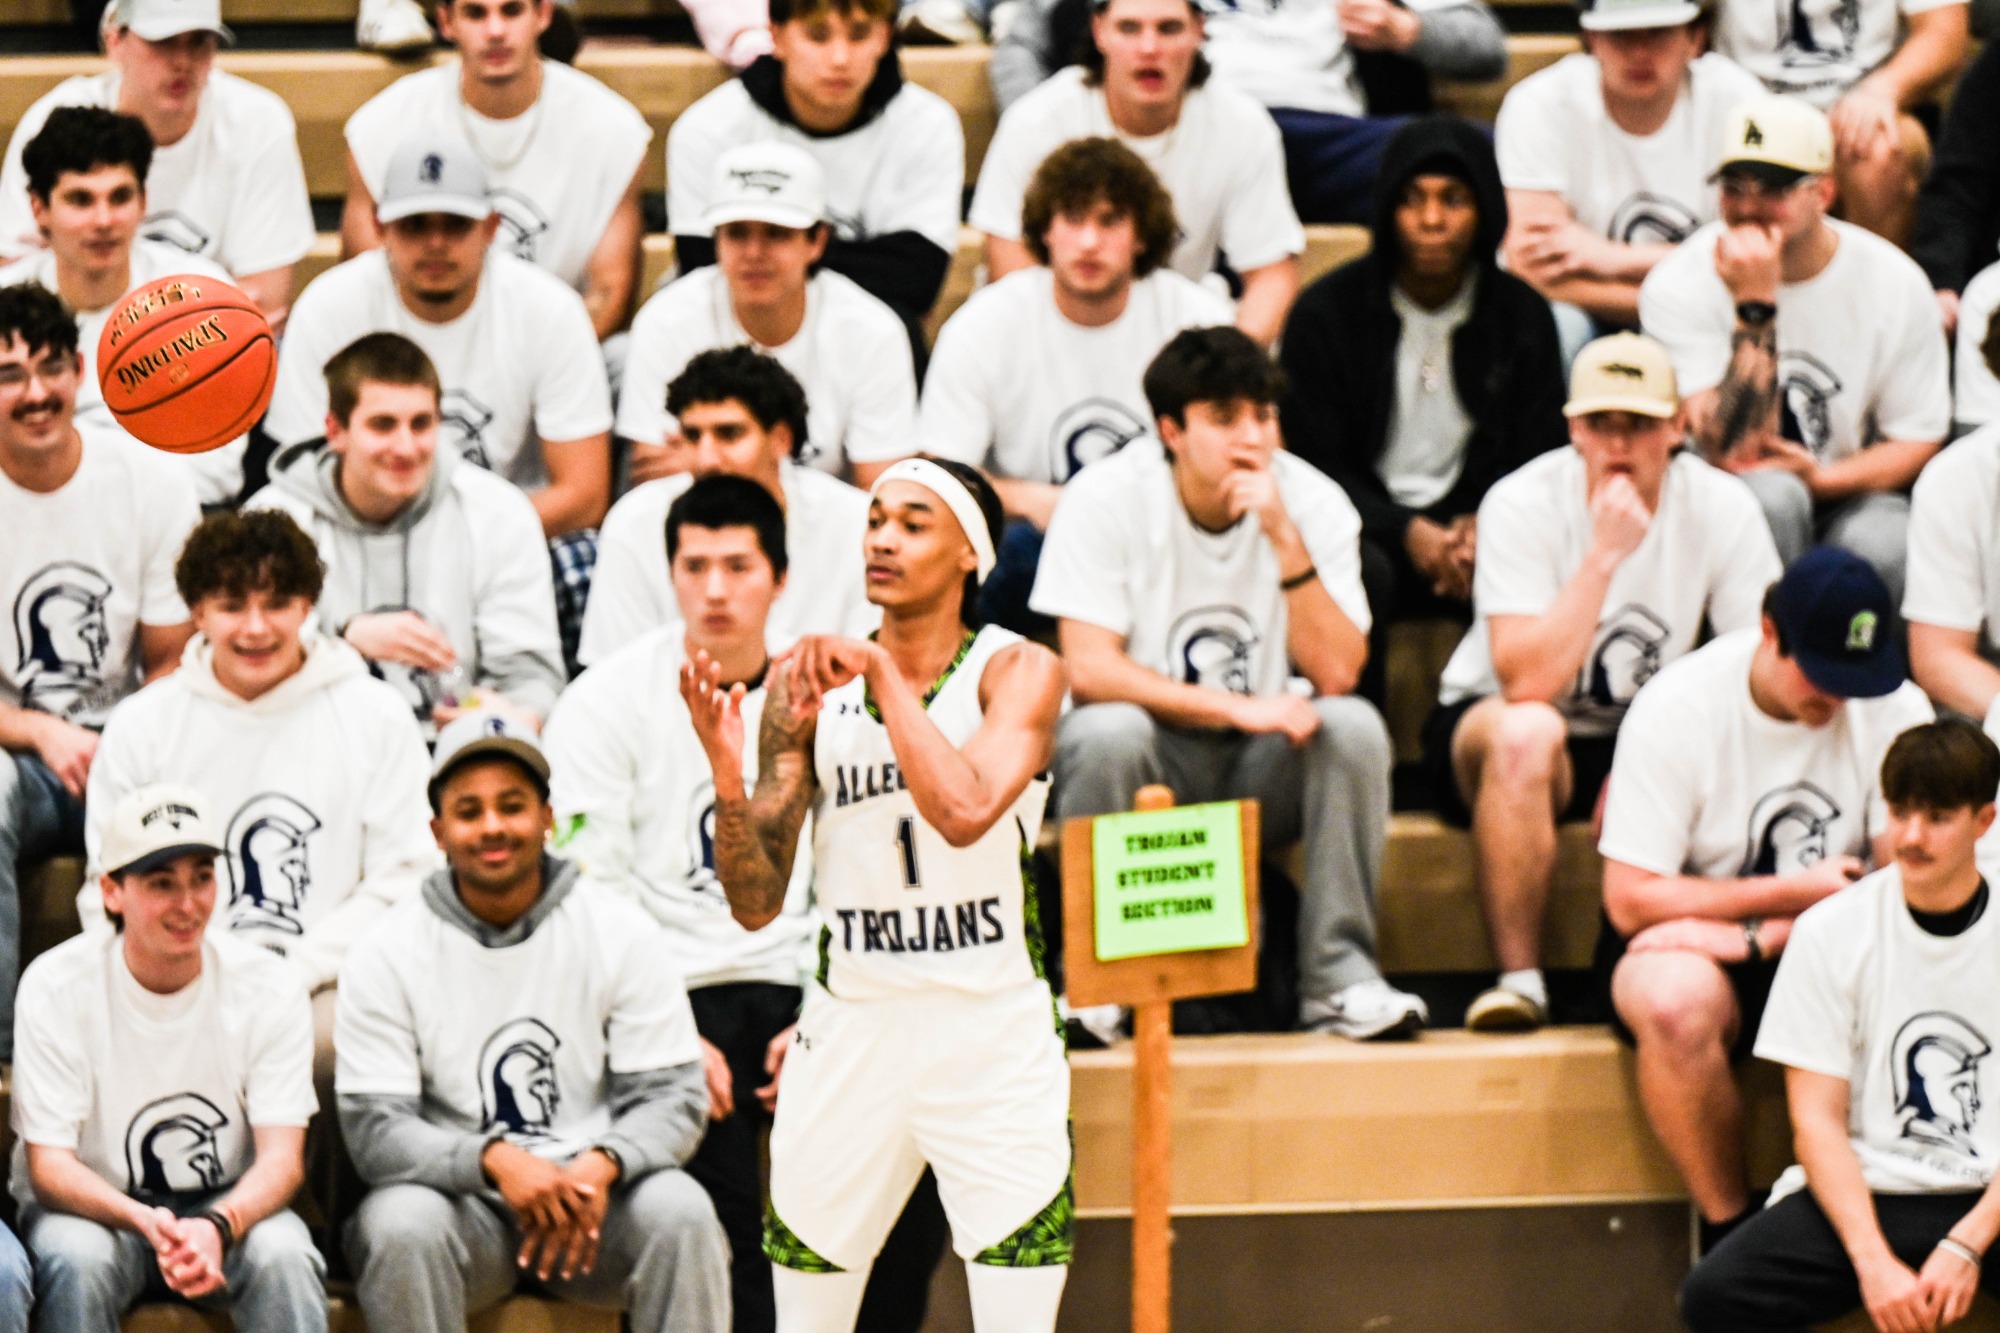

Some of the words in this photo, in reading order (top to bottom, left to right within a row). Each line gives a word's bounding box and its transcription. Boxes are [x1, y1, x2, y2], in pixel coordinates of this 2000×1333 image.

[116, 314, 228, 394] SPALDING
[895, 816, 921, 889] 1
[1124, 829, 1208, 854] TROJAN
[1117, 861, 1215, 889] STUDENT
[836, 896, 1004, 952] TROJANS
[1121, 896, 1214, 921] SECTION
